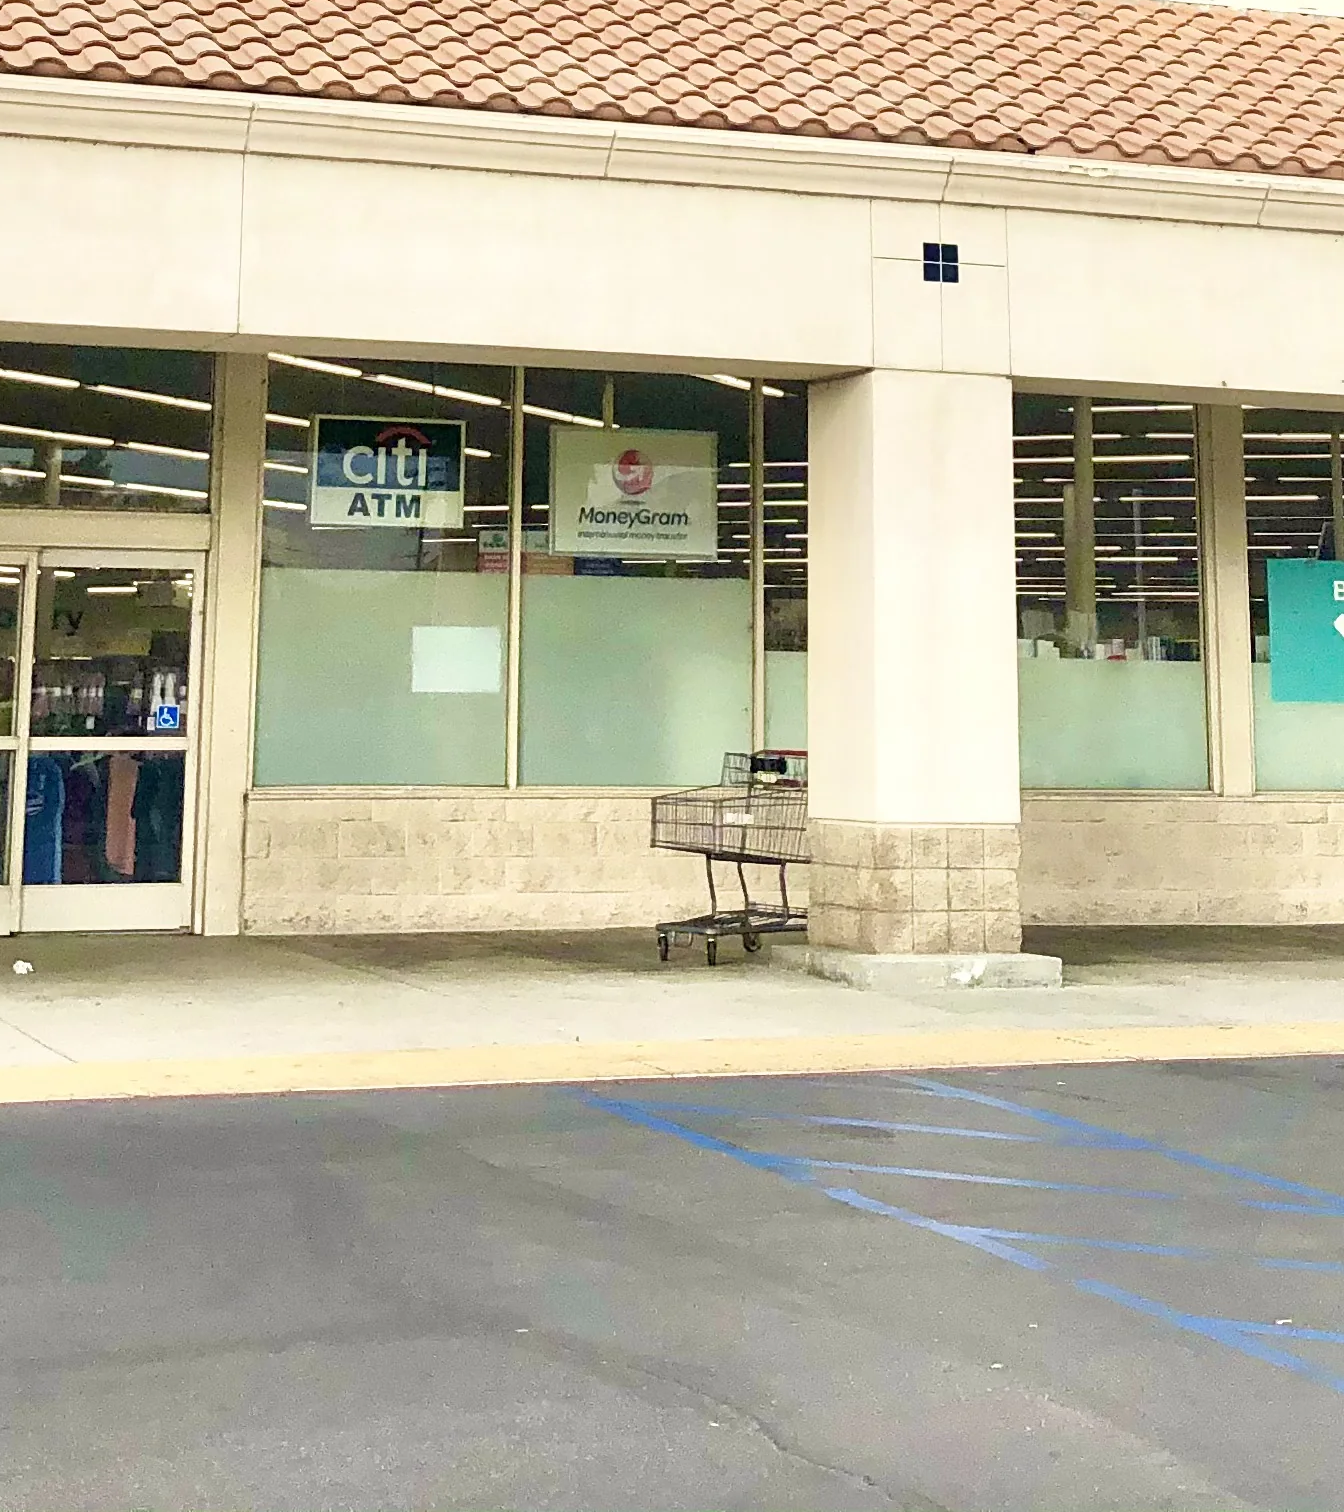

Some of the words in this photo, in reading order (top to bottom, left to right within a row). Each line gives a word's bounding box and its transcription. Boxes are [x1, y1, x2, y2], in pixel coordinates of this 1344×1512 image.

[343, 435, 427, 486] citi
[348, 492, 421, 518] ATM
[578, 506, 689, 529] MoneyGram
